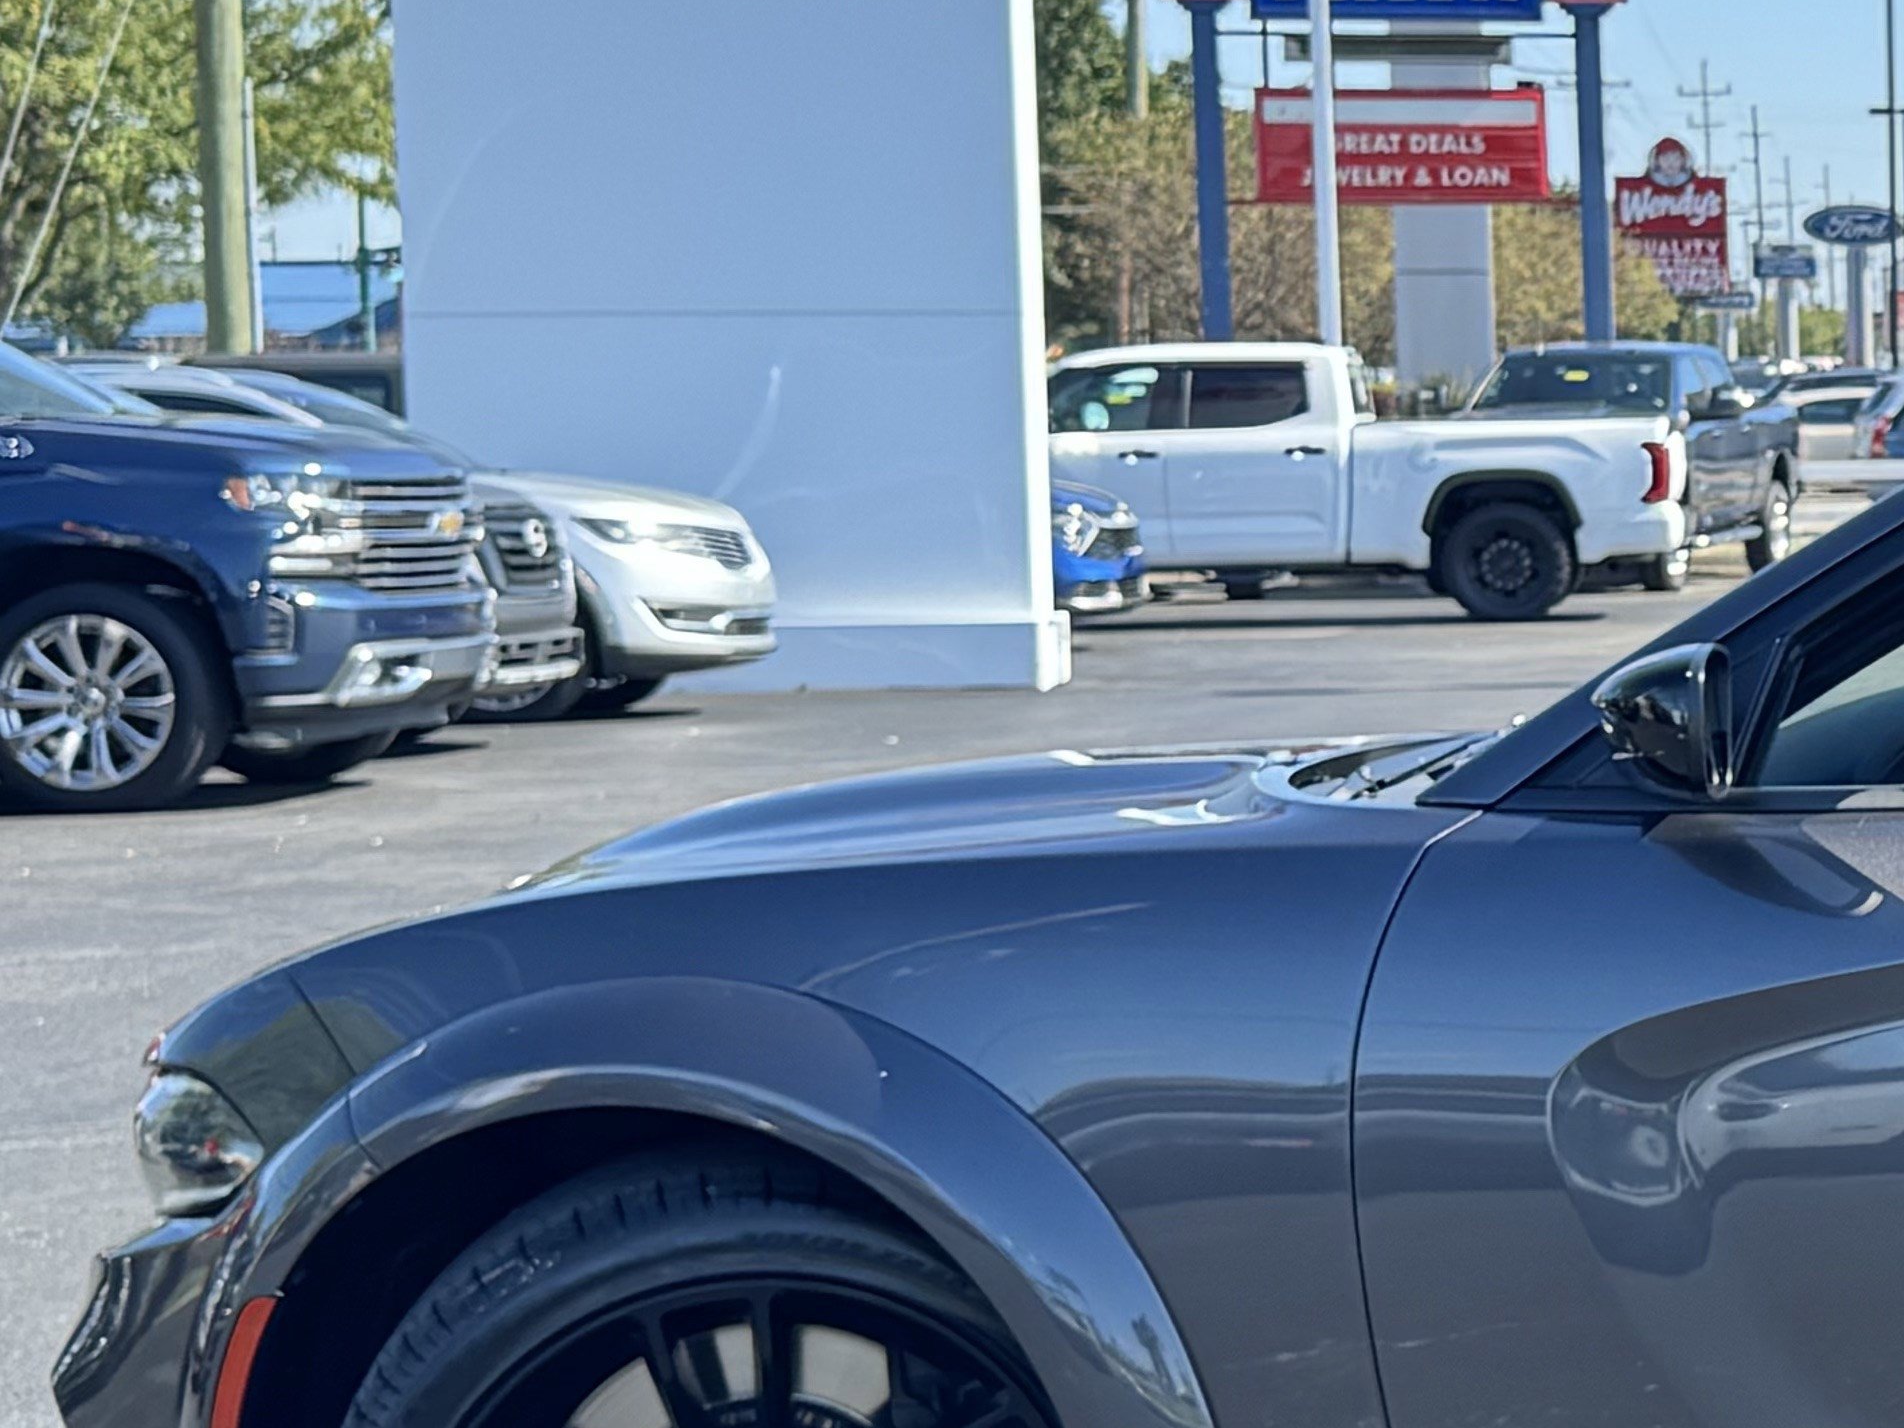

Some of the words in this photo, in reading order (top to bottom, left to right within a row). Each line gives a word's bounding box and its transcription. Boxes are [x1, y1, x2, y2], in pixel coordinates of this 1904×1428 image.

[1335, 133, 1401, 155] REAT
[1409, 133, 1487, 155] DEALS
[1302, 166, 1407, 188] JWELRY
[1414, 166, 1432, 187] &
[1441, 166, 1512, 188] LOAN
[1823, 214, 1888, 239] Ford
